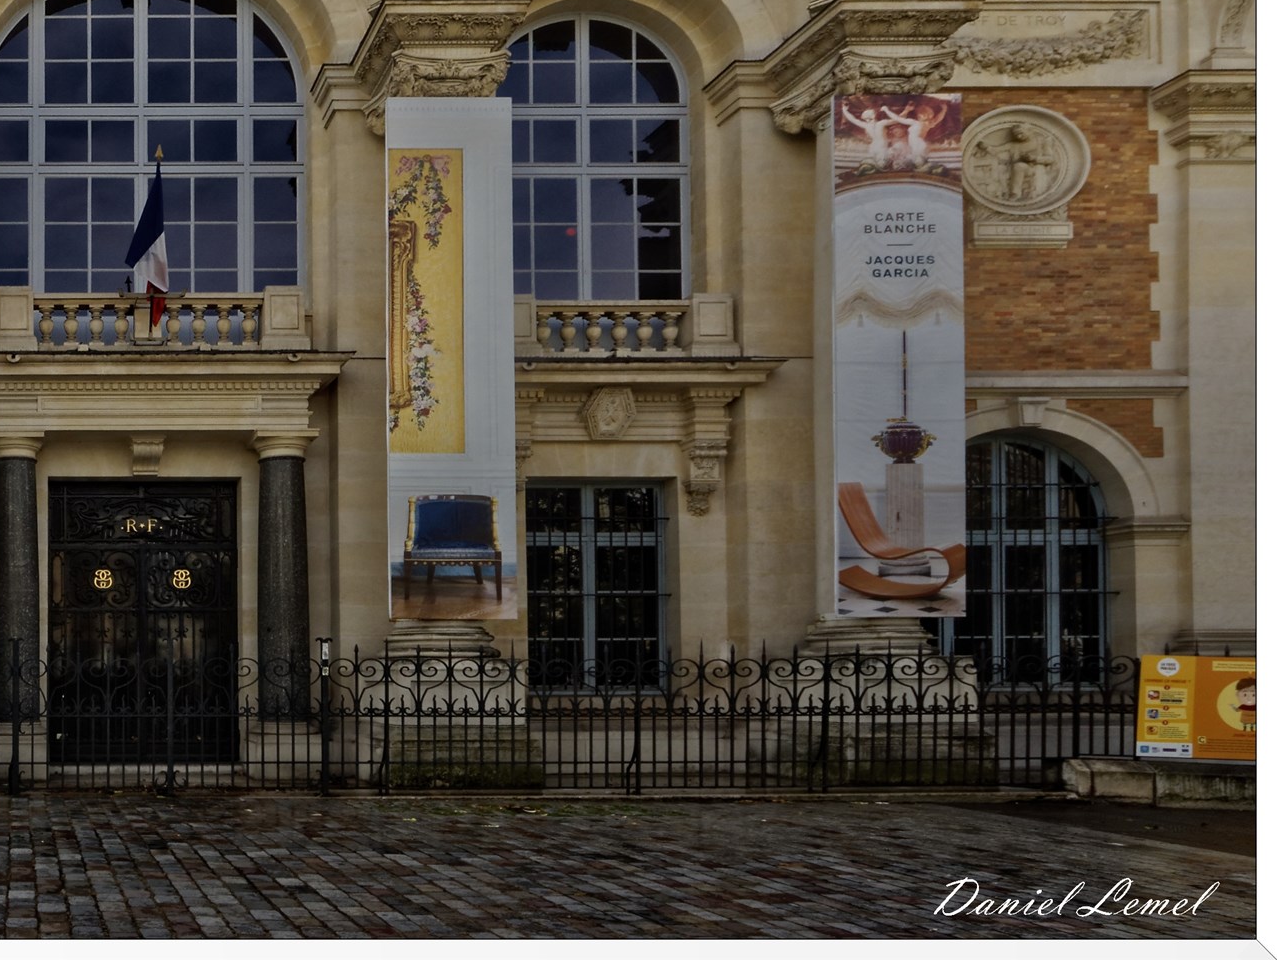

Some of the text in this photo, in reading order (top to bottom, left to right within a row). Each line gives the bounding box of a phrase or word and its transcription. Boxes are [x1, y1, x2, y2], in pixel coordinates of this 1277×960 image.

[996, 15, 1018, 26] DE
[1024, 15, 1066, 27] TROY
[874, 212, 925, 222] CARTE
[864, 224, 937, 234] BLANCHE
[865, 255, 936, 265] JACQUES
[872, 268, 930, 278] GARCIA
